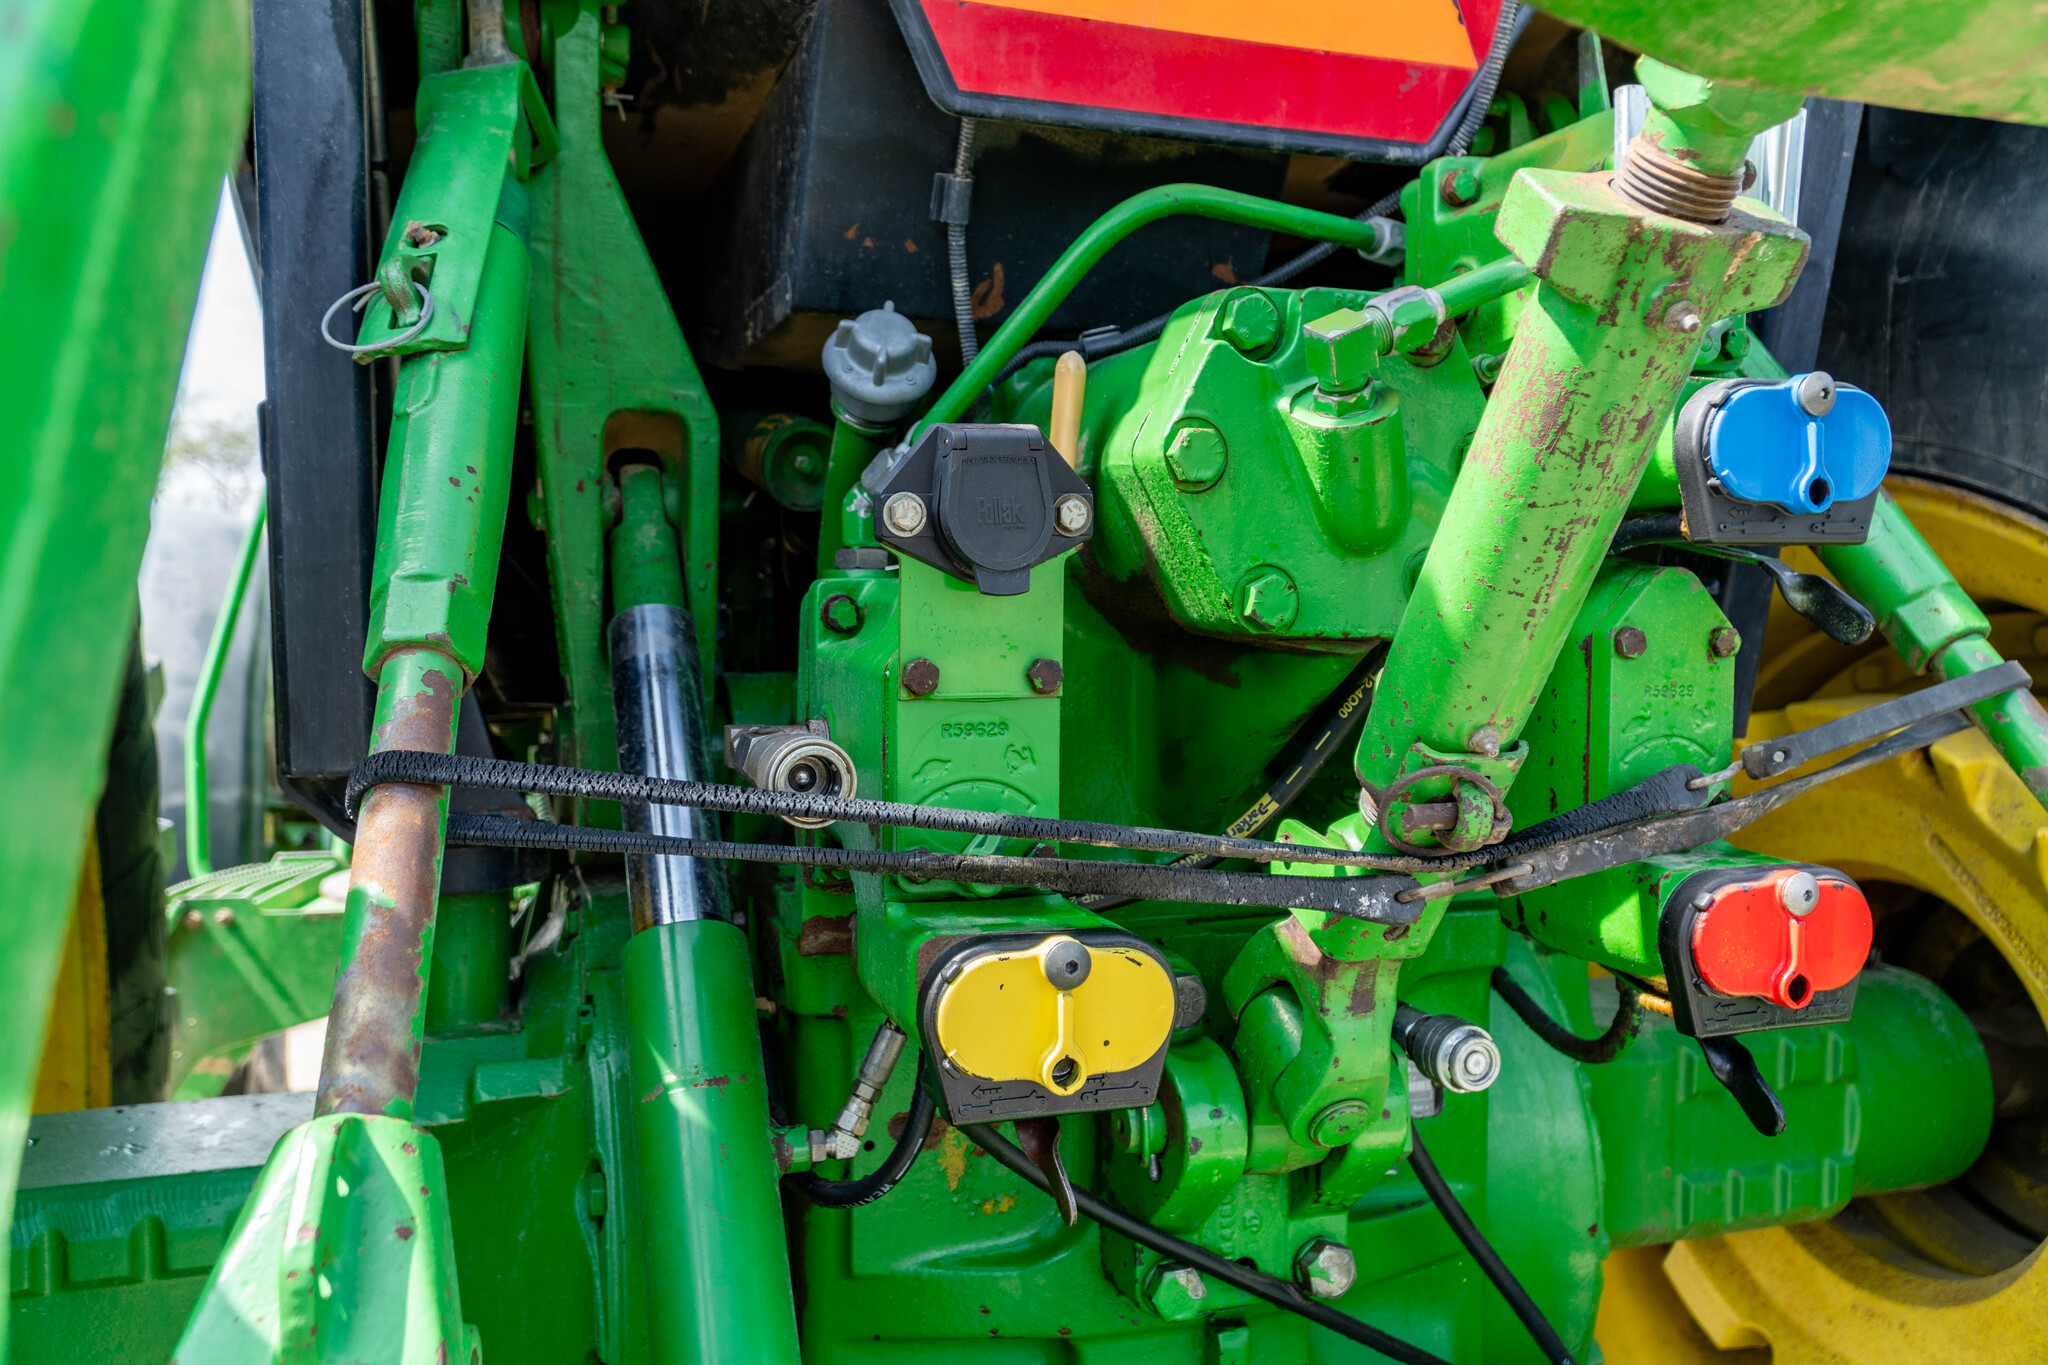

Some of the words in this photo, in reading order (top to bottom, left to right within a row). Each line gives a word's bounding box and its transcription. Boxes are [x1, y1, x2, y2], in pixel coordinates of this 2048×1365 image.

[975, 496, 1025, 526] Pollak
[1643, 683, 1695, 699] R59629
[940, 721, 1009, 740] R59629
[1230, 800, 1273, 837] Parker
